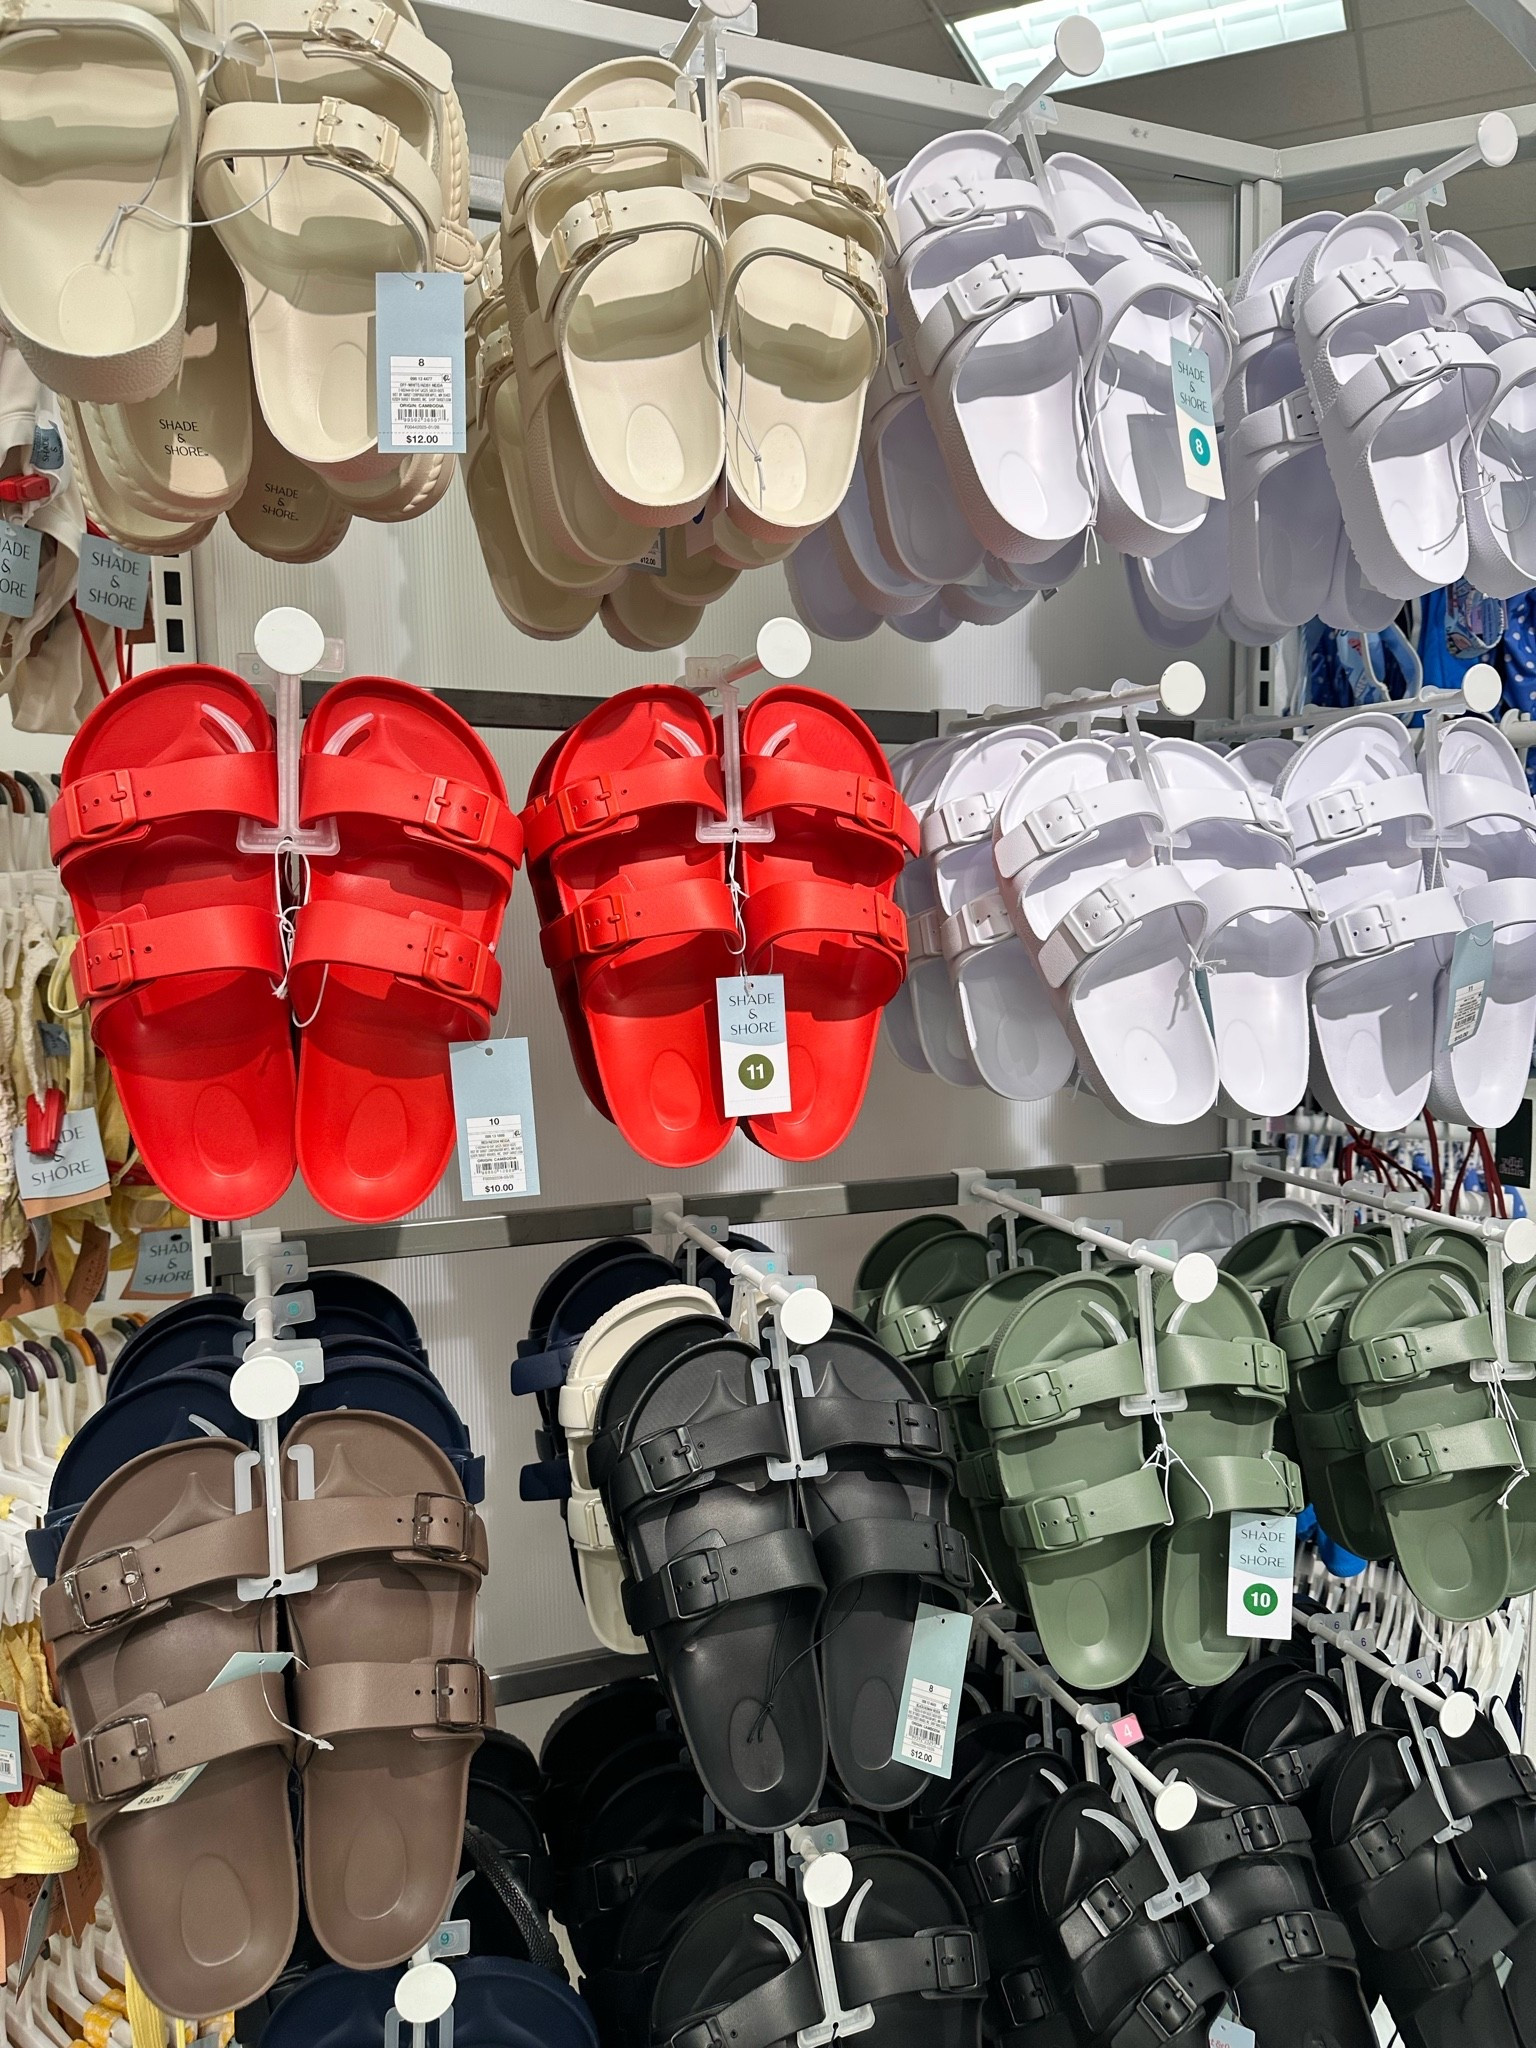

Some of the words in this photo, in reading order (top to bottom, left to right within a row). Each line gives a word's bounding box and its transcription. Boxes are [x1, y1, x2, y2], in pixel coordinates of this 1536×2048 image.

[1039, 100, 1047, 111] 8
[418, 358, 425, 367] 8
[1178, 360, 1206, 383] SHADE
[1189, 381, 1196, 393] &
[1180, 392, 1209, 413] SHORE
[159, 419, 199, 432] SHADE
[176, 433, 187, 444] &
[406, 434, 439, 444] $12.00
[1195, 438, 1204, 456] 8
[264, 483, 299, 499] SHADE
[277, 497, 286, 507] &
[0, 539, 31, 561] ADE
[0, 557, 12, 575] &
[91, 551, 141, 576] SHADE
[109, 575, 121, 589] &
[88, 588, 138, 611] SHORE
[728, 992, 776, 1007] SHADE
[748, 1008, 758, 1020] &
[730, 1021, 777, 1036] SHORE
[746, 1063, 765, 1080] 11
[489, 1117, 500, 1126] 10
[31, 1158, 95, 1187] SHORE
[485, 1183, 514, 1193] $10.00
[710, 1224, 718, 1234] 9
[167, 1257, 177, 1270] &
[286, 1264, 293, 1275] 7
[143, 1270, 193, 1285] SHORE
[294, 1360, 304, 1374] 8
[1240, 1528, 1286, 1543] SHADE
[1257, 1543, 1267, 1553] &
[1240, 1554, 1286, 1568] SHORE
[1251, 1591, 1271, 1608] 10
[1333, 1621, 1340, 1630] 6
[1360, 1637, 1367, 1647] 6
[1415, 1669, 1422, 1679] 6
[928, 1684, 934, 1693] 8
[1103, 1710, 1111, 1721] 8
[1123, 1724, 1133, 1738] 4
[910, 1749, 933, 1763] $12.00
[826, 1833, 834, 1846] 9
[440, 1932, 450, 1946] 9
